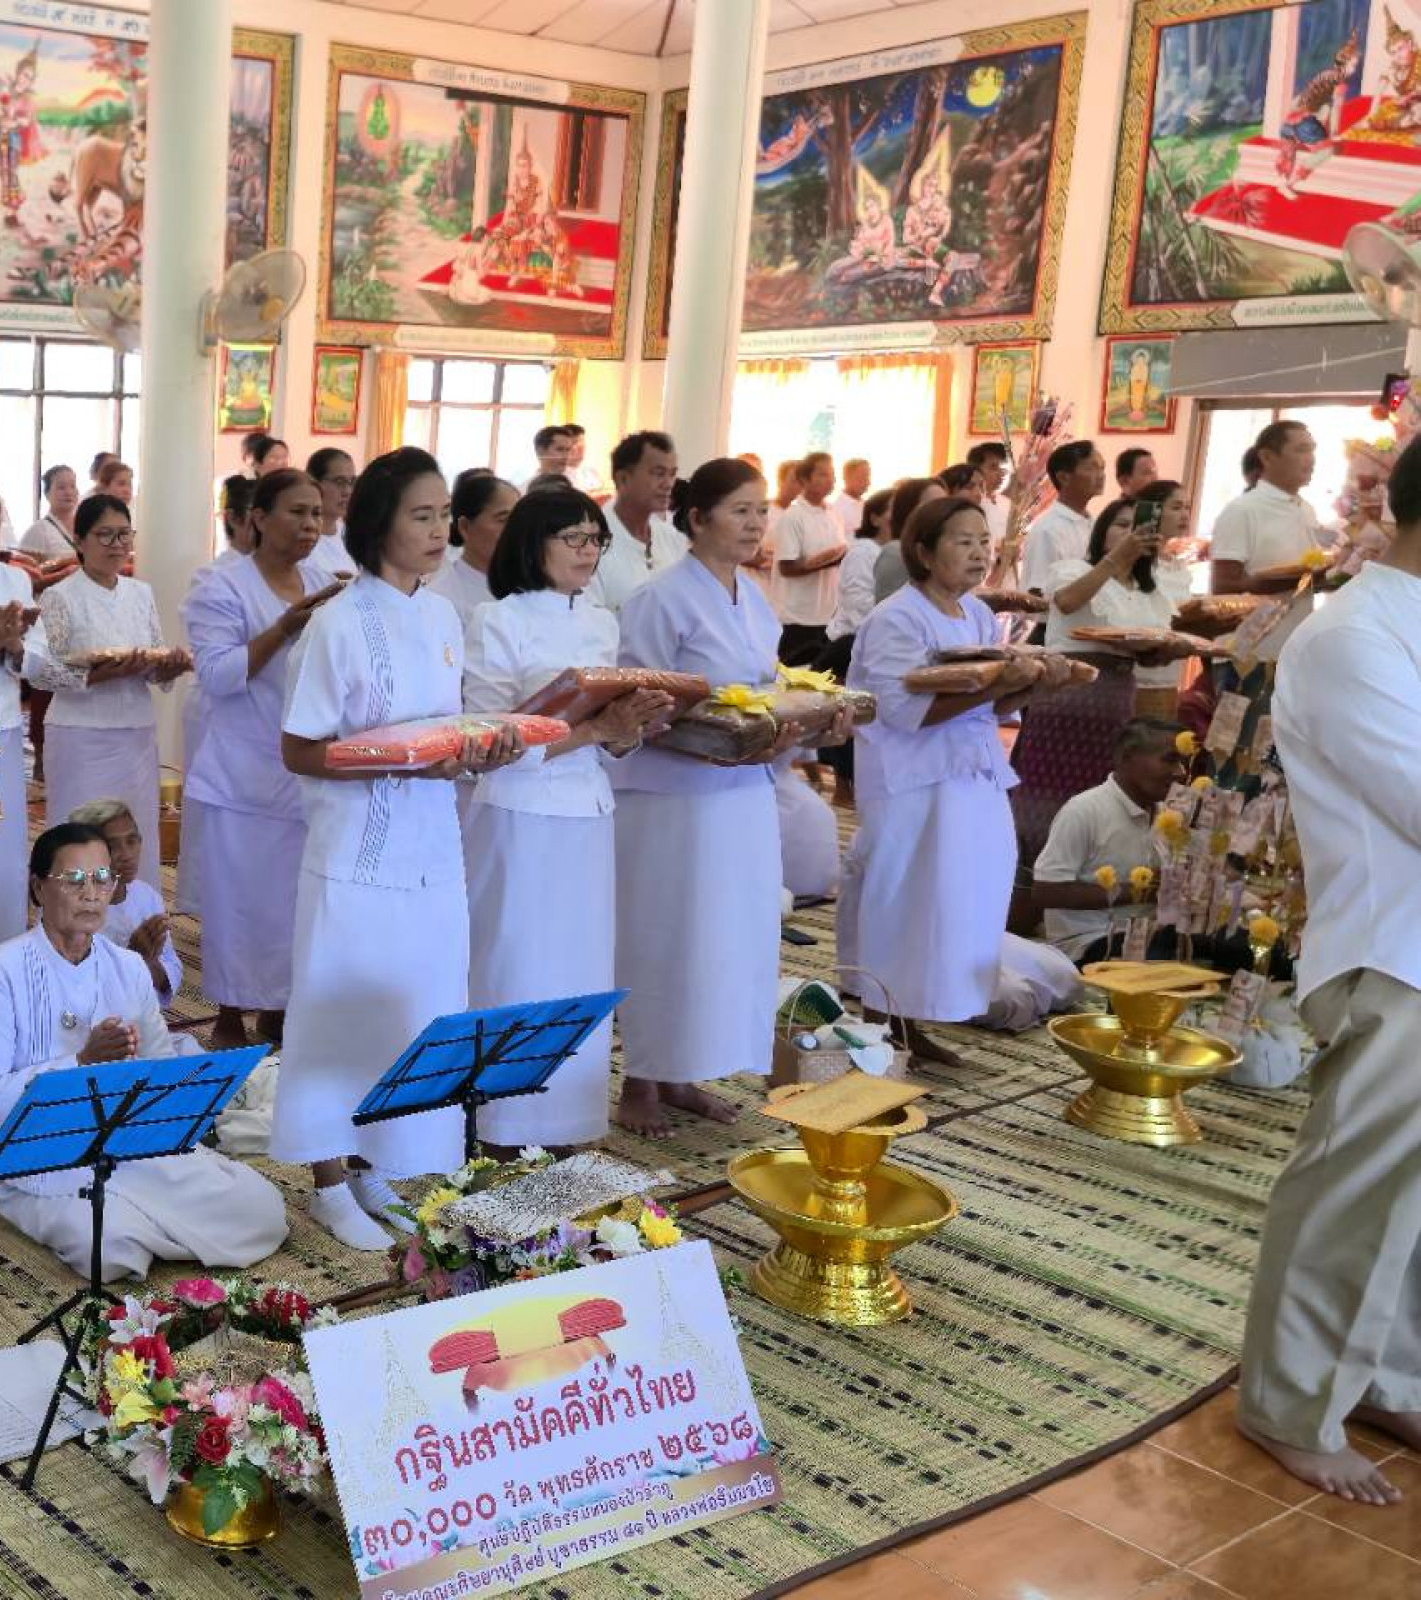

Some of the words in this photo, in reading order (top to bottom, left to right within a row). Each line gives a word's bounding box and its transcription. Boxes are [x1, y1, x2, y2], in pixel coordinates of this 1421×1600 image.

[363, 1492, 497, 1556] ๓๐,๐๐๐
[502, 1479, 534, 1508] วัด
[537, 1447, 655, 1507] พุทธศักราช
[657, 1411, 759, 1461] ๒๕๖๘
[394, 1361, 696, 1492] กฐินสามัคคีทั่วไทย
